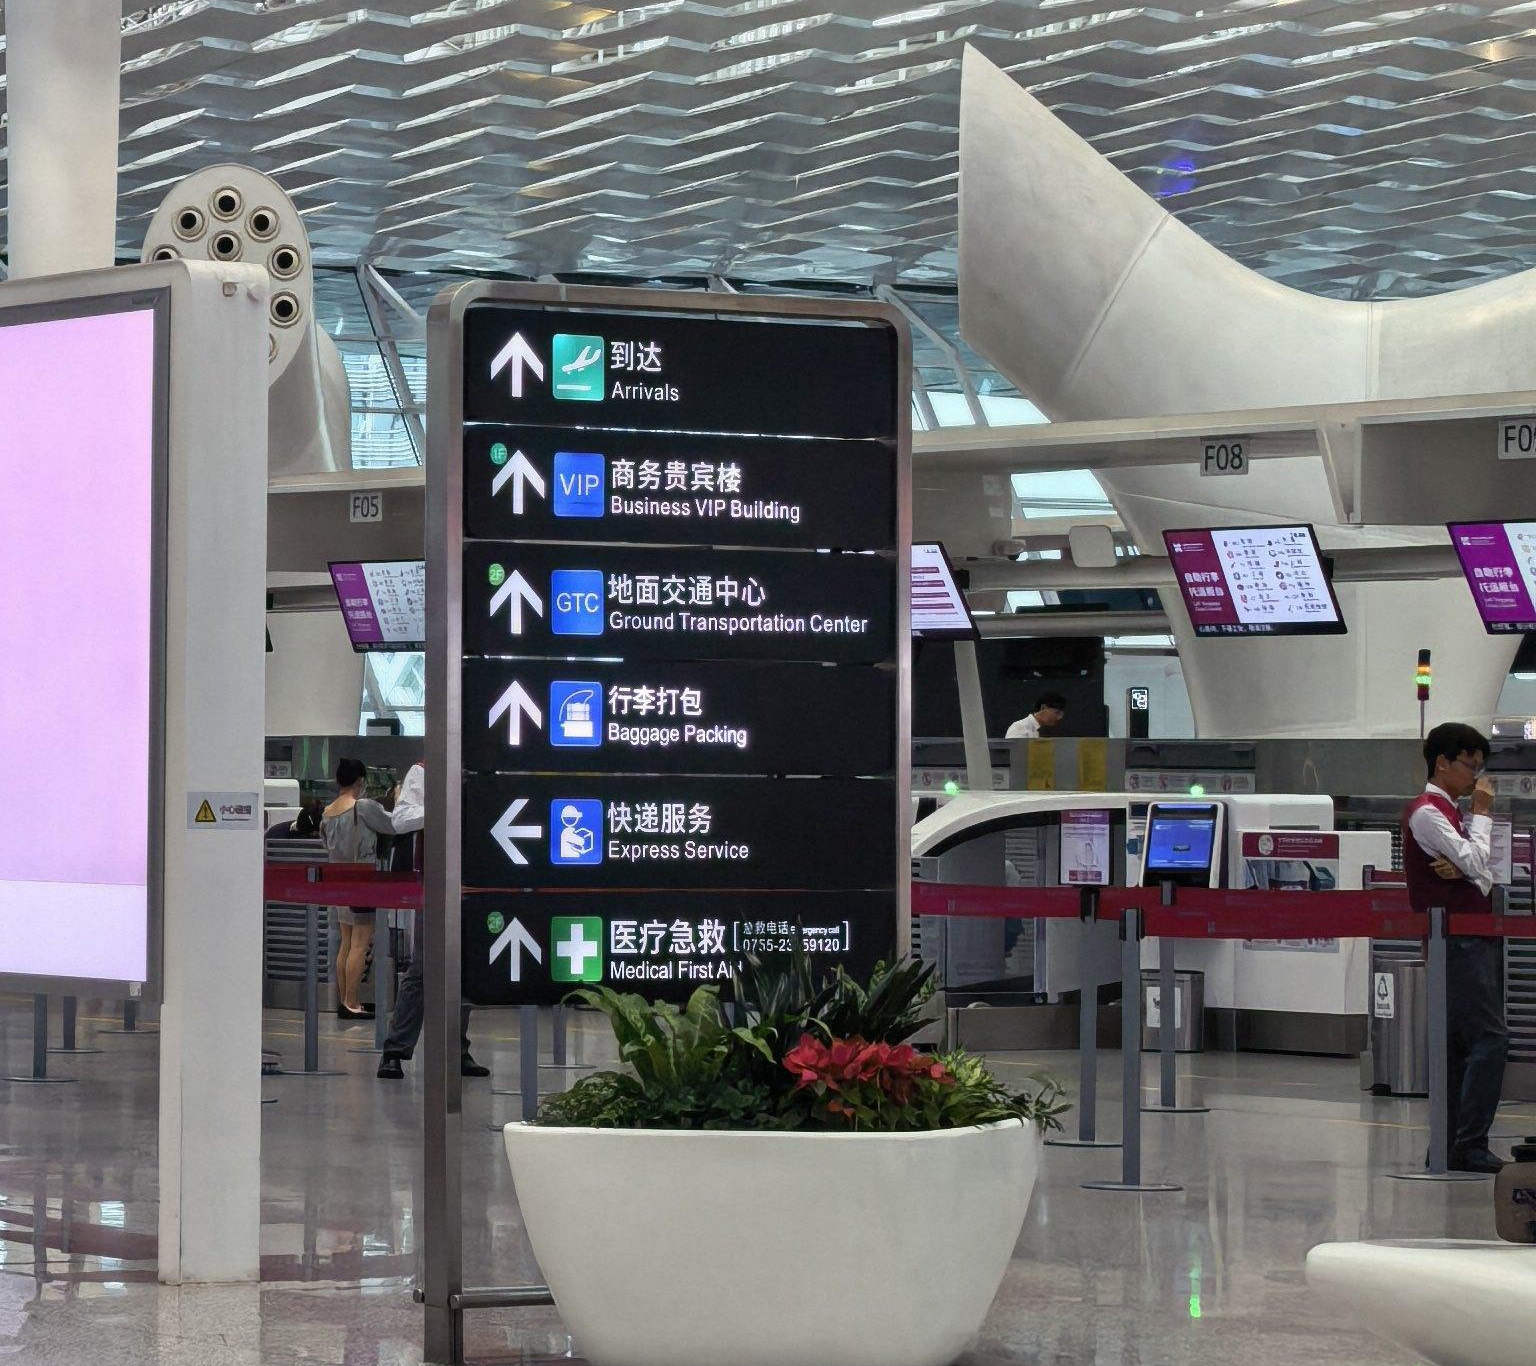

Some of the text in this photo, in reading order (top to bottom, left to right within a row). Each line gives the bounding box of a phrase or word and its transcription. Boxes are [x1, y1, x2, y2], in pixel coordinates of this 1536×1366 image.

[611, 341, 663, 373] 到达
[611, 383, 680, 402] Arrivals
[1504, 424, 1536, 453] F0
[1205, 444, 1243, 472] F08
[560, 473, 599, 497] VIP
[611, 459, 742, 494] 商务贵宾楼
[352, 495, 379, 518] F05
[611, 497, 801, 524] Business VIP Building
[608, 574, 766, 606] 地面交通中心
[556, 592, 599, 614] GTC
[609, 612, 867, 635] Ground Transportation Center
[608, 686, 702, 717] 行李打包
[608, 723, 747, 747] Baggage Packing
[607, 802, 712, 834] 快递服务
[608, 841, 749, 860] Express Service
[609, 920, 725, 955] 医疗急救
[790, 925, 827, 936] eergency
[743, 938, 840, 952] 0755-2359120
[609, 960, 672, 978] Medical
[677, 960, 713, 978] First
